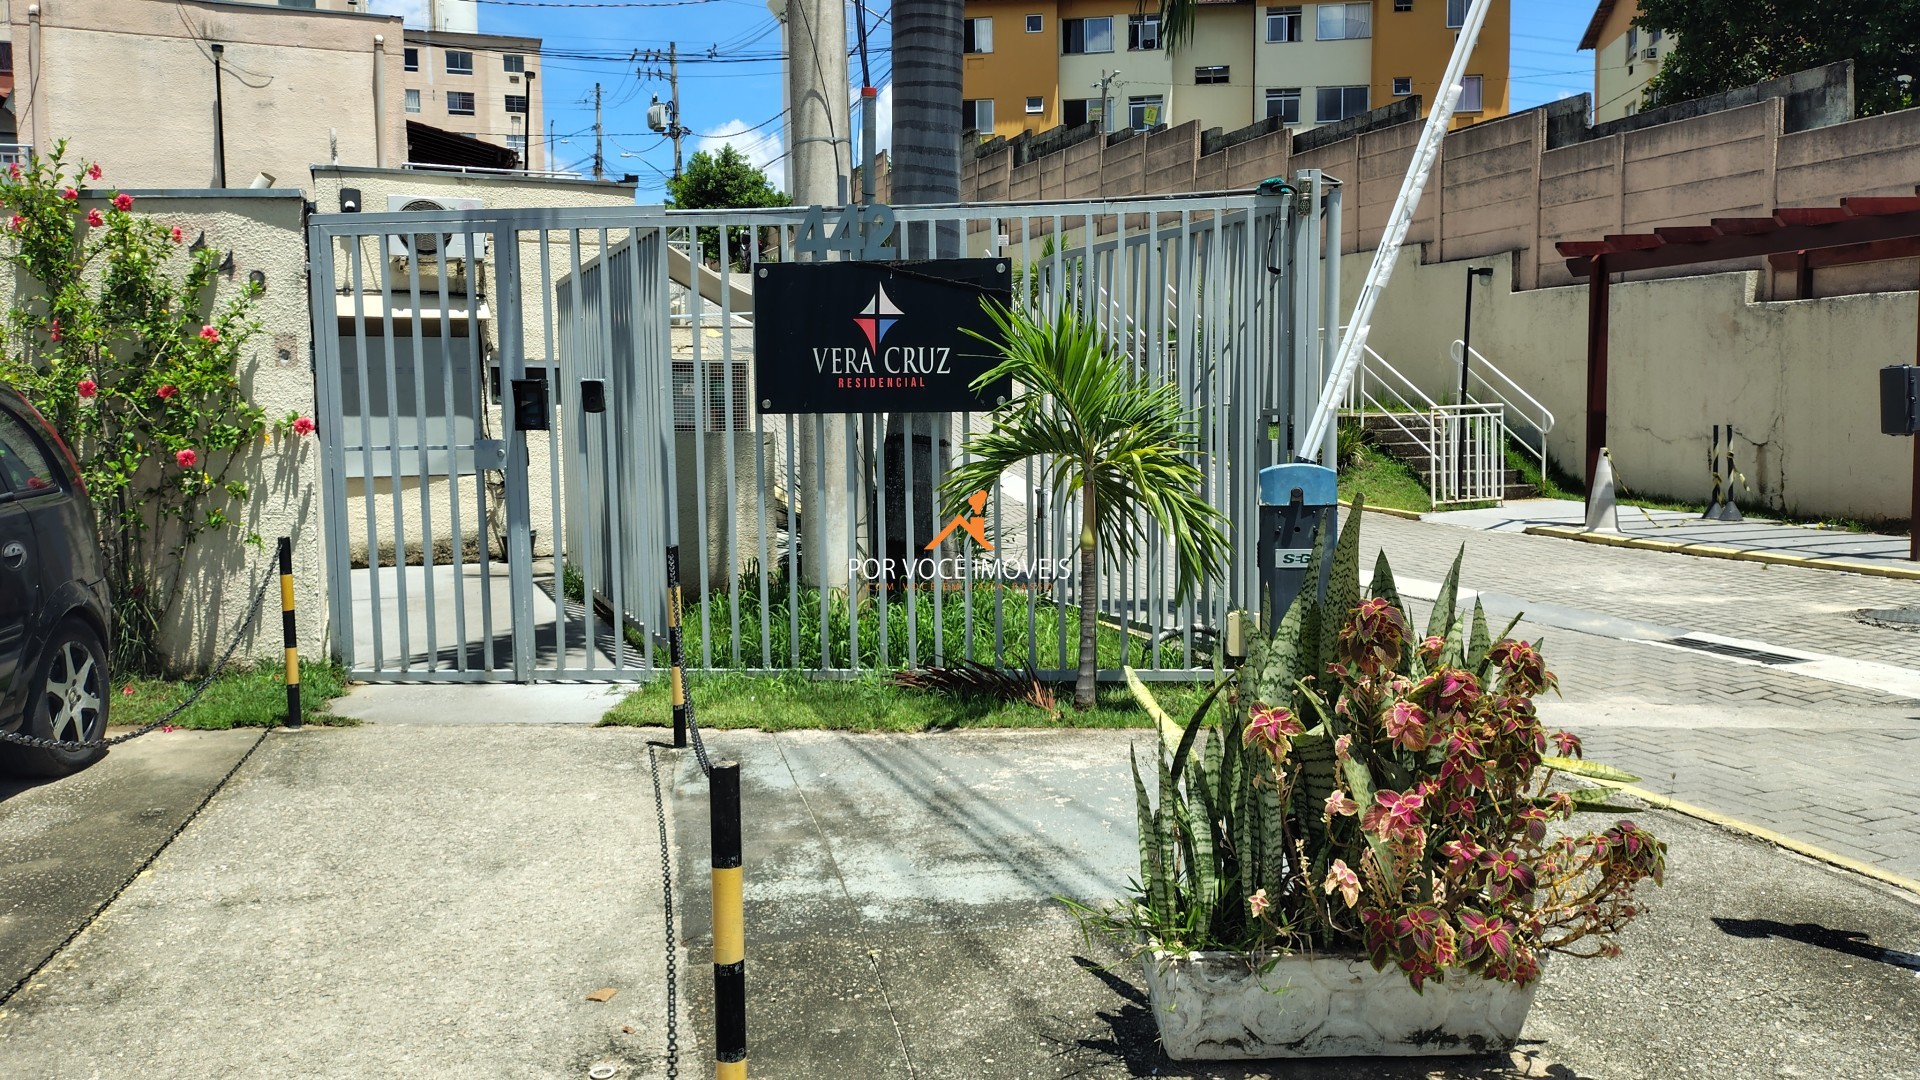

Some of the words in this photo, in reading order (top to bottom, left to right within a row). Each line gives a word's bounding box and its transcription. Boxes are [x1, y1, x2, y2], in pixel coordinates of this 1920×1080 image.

[796, 204, 896, 261] 442
[812, 347, 875, 374] VERA
[884, 347, 950, 374] CRUZ
[838, 376, 925, 389] RESIDENCIAL
